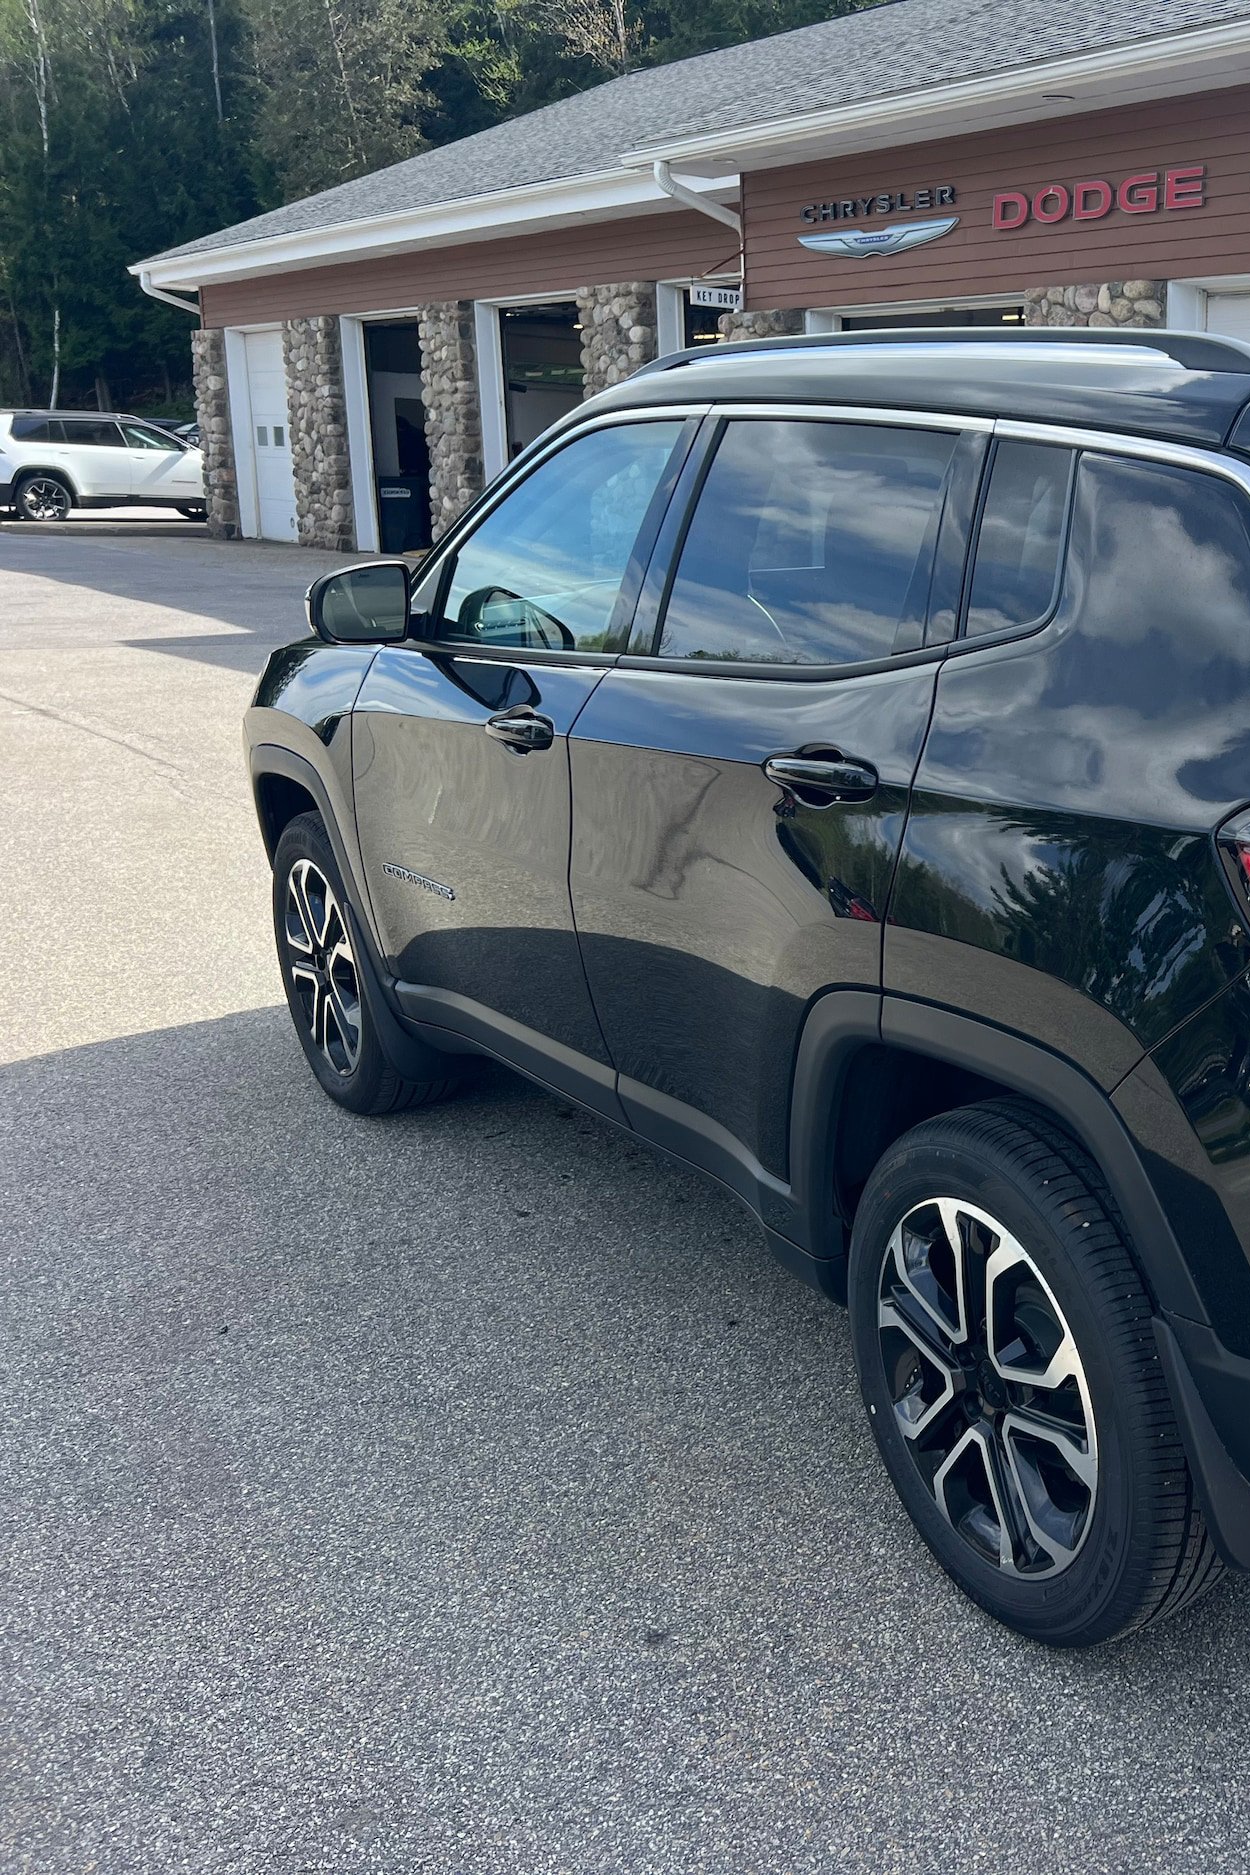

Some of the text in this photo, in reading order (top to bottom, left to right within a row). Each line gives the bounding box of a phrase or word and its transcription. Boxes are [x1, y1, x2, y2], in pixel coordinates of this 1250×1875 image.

[800, 184, 954, 224] CHRYSLER
[992, 165, 1205, 230] DODGE
[697, 290, 740, 305] KEY DROP
[382, 862, 456, 901] COMPASS
